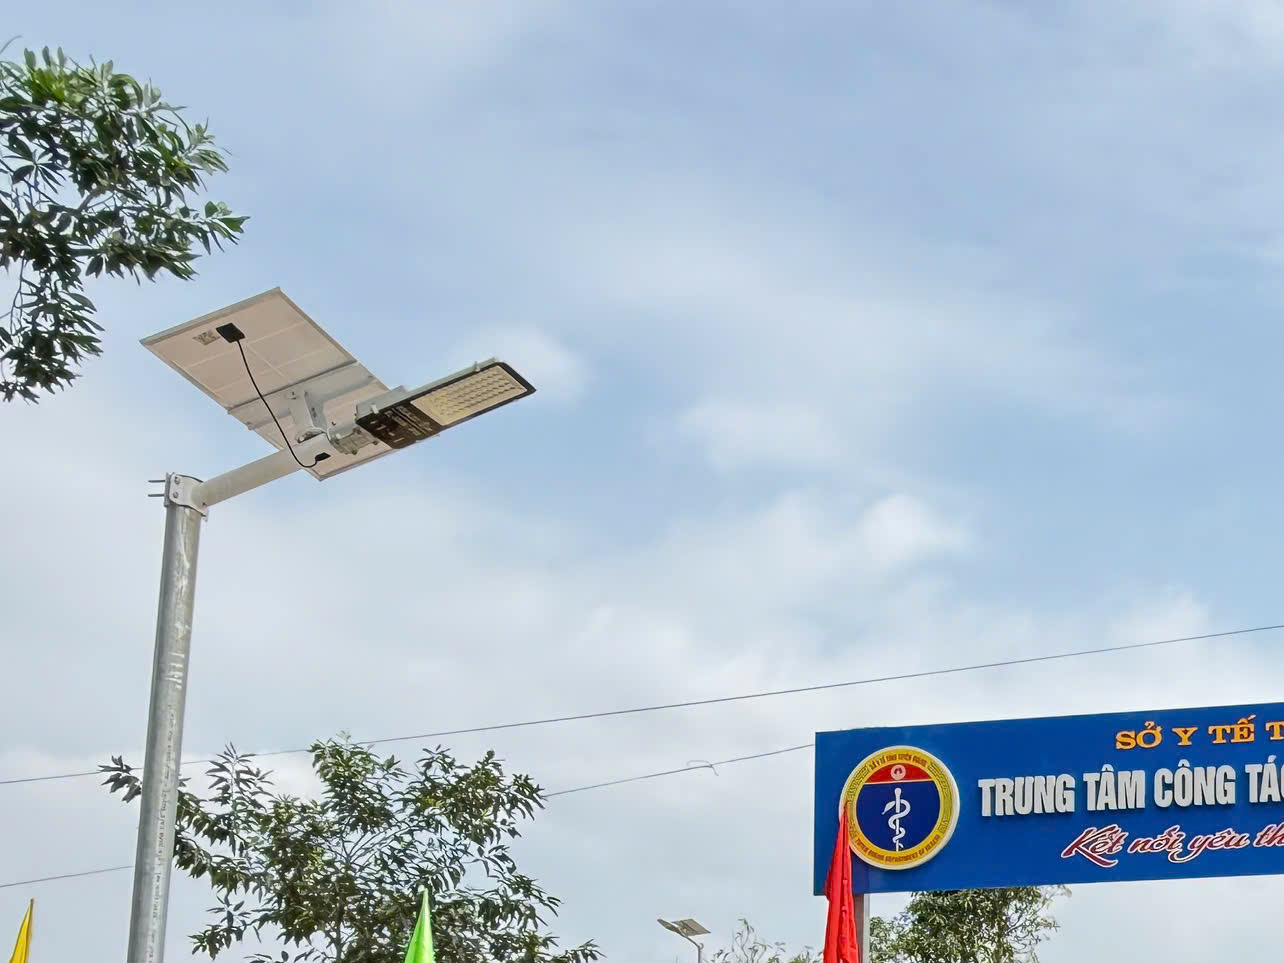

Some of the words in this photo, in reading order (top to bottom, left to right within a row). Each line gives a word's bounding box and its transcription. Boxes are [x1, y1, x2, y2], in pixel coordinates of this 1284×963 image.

[1115, 720, 1163, 750] SỞ
[1171, 727, 1198, 746] Y
[1208, 714, 1256, 744] TẾ
[978, 773, 1076, 817] TRUNG
[1083, 764, 1145, 811] TÂM
[1154, 759, 1236, 808] CÔNG
[1060, 824, 1129, 868] Kết
[1128, 825, 1186, 853] nối
[1167, 828, 1250, 864] yêu
